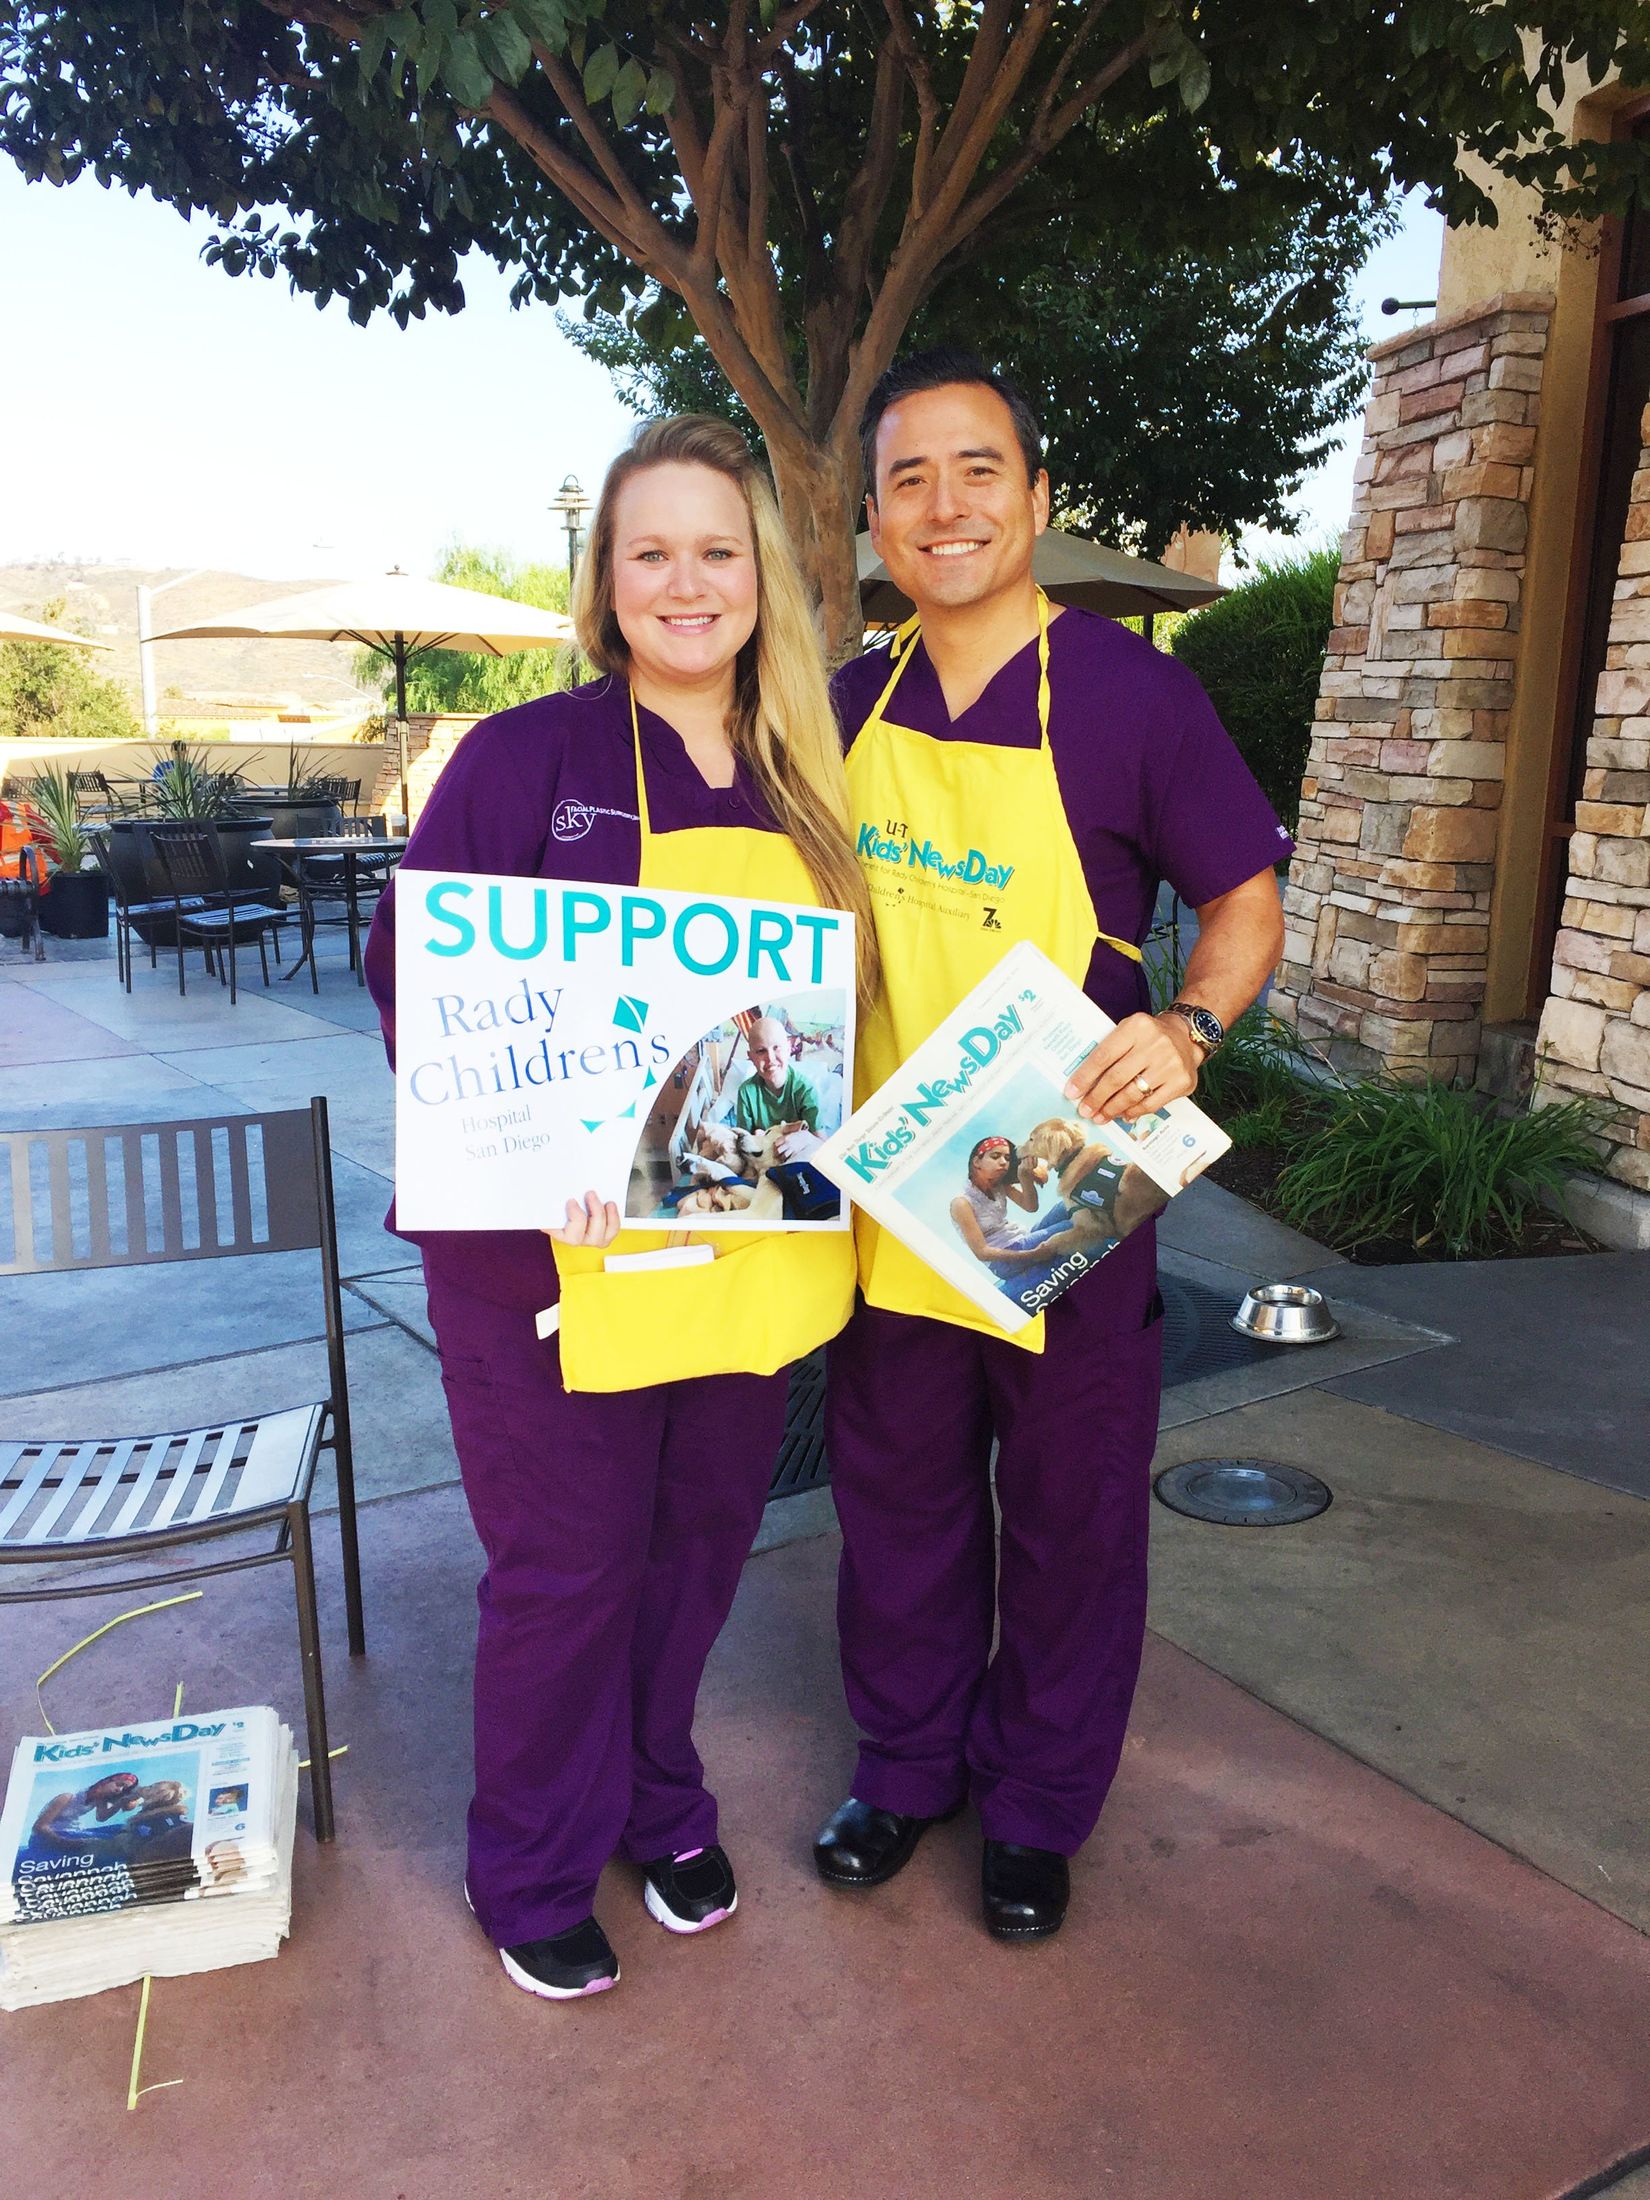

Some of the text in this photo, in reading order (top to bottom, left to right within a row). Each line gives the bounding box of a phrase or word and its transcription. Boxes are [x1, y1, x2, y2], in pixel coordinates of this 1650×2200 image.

[857, 823, 1015, 890] Kids' NewsDay
[424, 881, 839, 984] SUPPORT
[432, 978, 564, 1038] Rady
[844, 1116, 916, 1184] Kids'
[900, 1003, 1025, 1128] NewsDay
[1018, 989, 1037, 1006] $2
[461, 1105, 532, 1134] Hospital
[1182, 1135, 1195, 1149] 6
[465, 1130, 551, 1161] San Diego
[1020, 1251, 1089, 1309] Saving
[33, 1742, 100, 1763] Kids'
[102, 1723, 226, 1752] NewsDay
[19, 1854, 94, 1874] Saving
